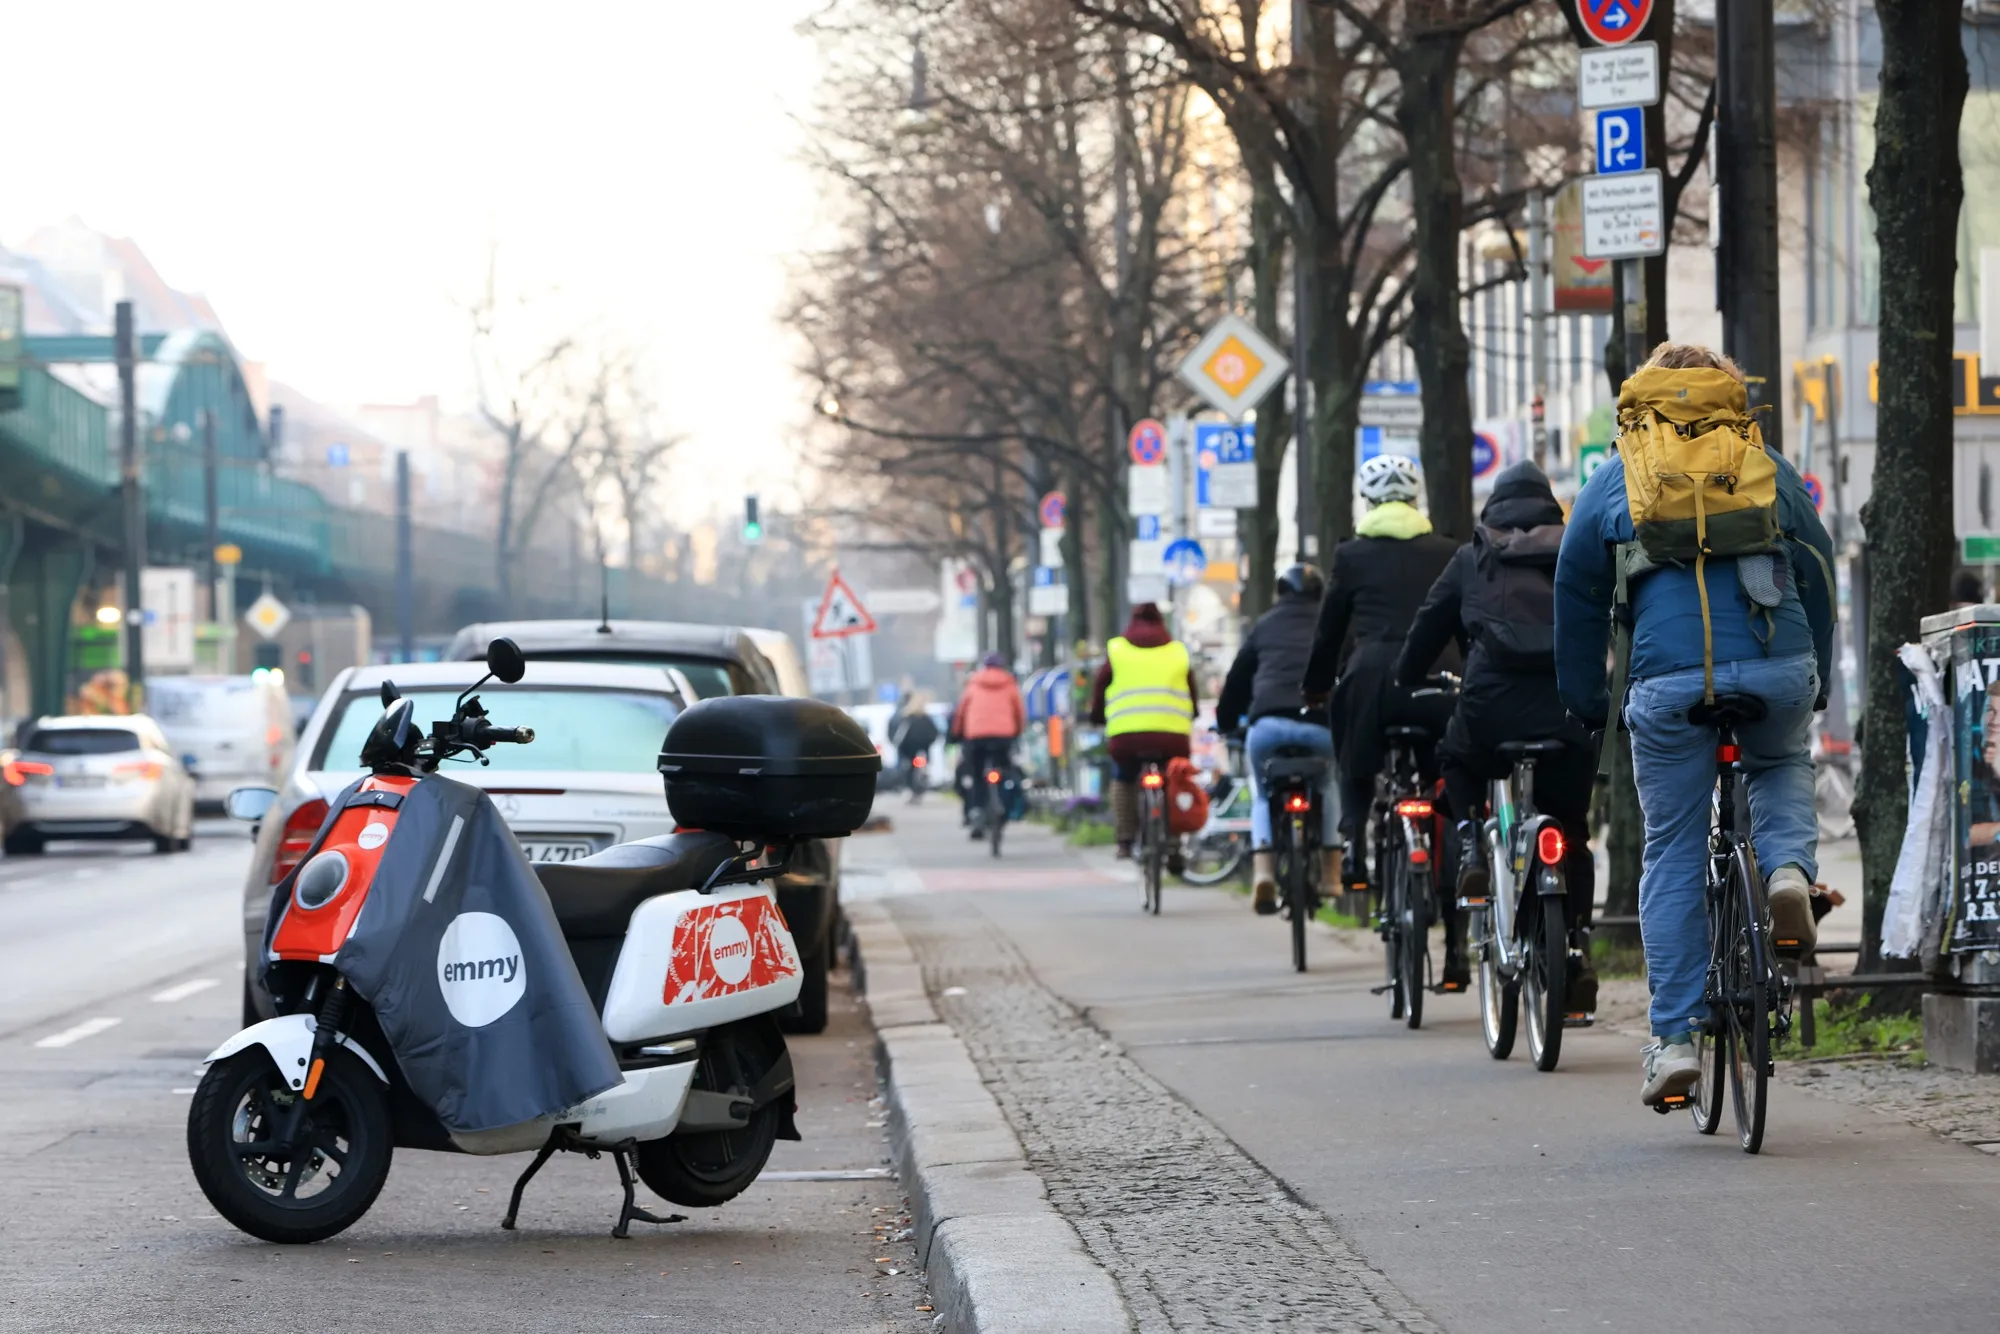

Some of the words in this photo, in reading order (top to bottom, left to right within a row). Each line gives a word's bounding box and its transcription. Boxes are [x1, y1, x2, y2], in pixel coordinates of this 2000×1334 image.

[1603, 116, 1630, 168] P
[714, 940, 748, 960] emmy
[444, 955, 518, 983] emmy
